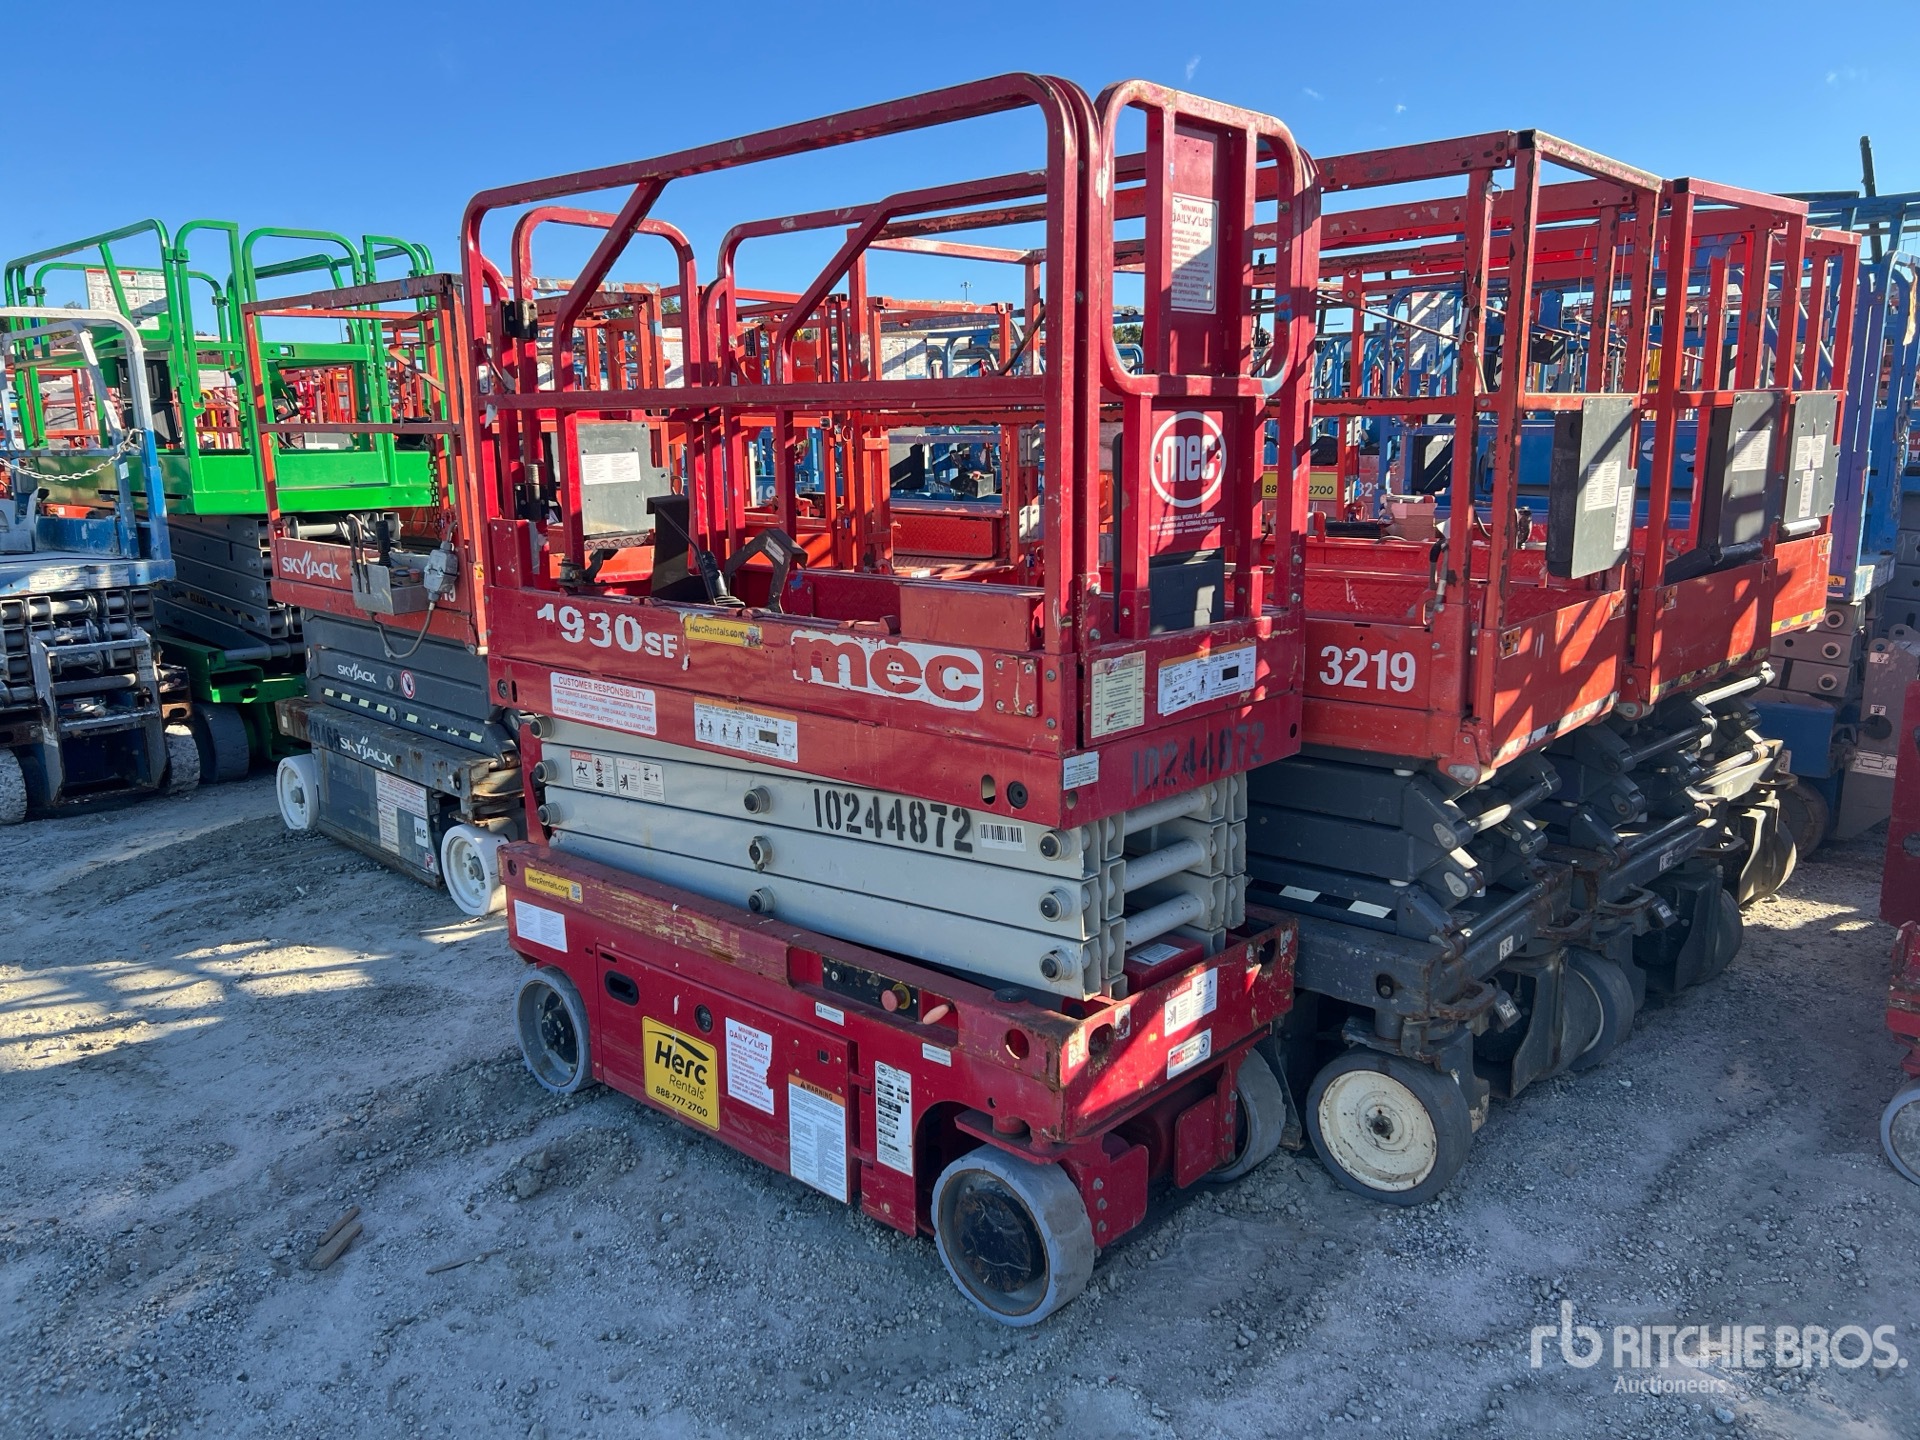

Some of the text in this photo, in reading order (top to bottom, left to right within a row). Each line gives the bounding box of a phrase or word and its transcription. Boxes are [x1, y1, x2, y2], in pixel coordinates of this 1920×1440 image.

[1162, 434, 1215, 483] mec
[281, 551, 342, 580] SKYJACK
[690, 622, 745, 639] HercRentals.com
[337, 663, 377, 684] SKYJACK
[793, 636, 981, 703] mec
[1320, 645, 1416, 692] 3219
[558, 676, 646, 700] CUSTOMER RESPONSIBILITY
[813, 788, 973, 853] 10244872
[528, 874, 570, 893] HercRentals.com
[1171, 981, 1191, 998] DANGER
[729, 1029, 768, 1052] DAILY LIST
[654, 1040, 708, 1086] Herc
[669, 1074, 705, 1100] Rentals
[806, 1084, 833, 1100] WARNING
[655, 1085, 708, 1117] 888-777-2700
